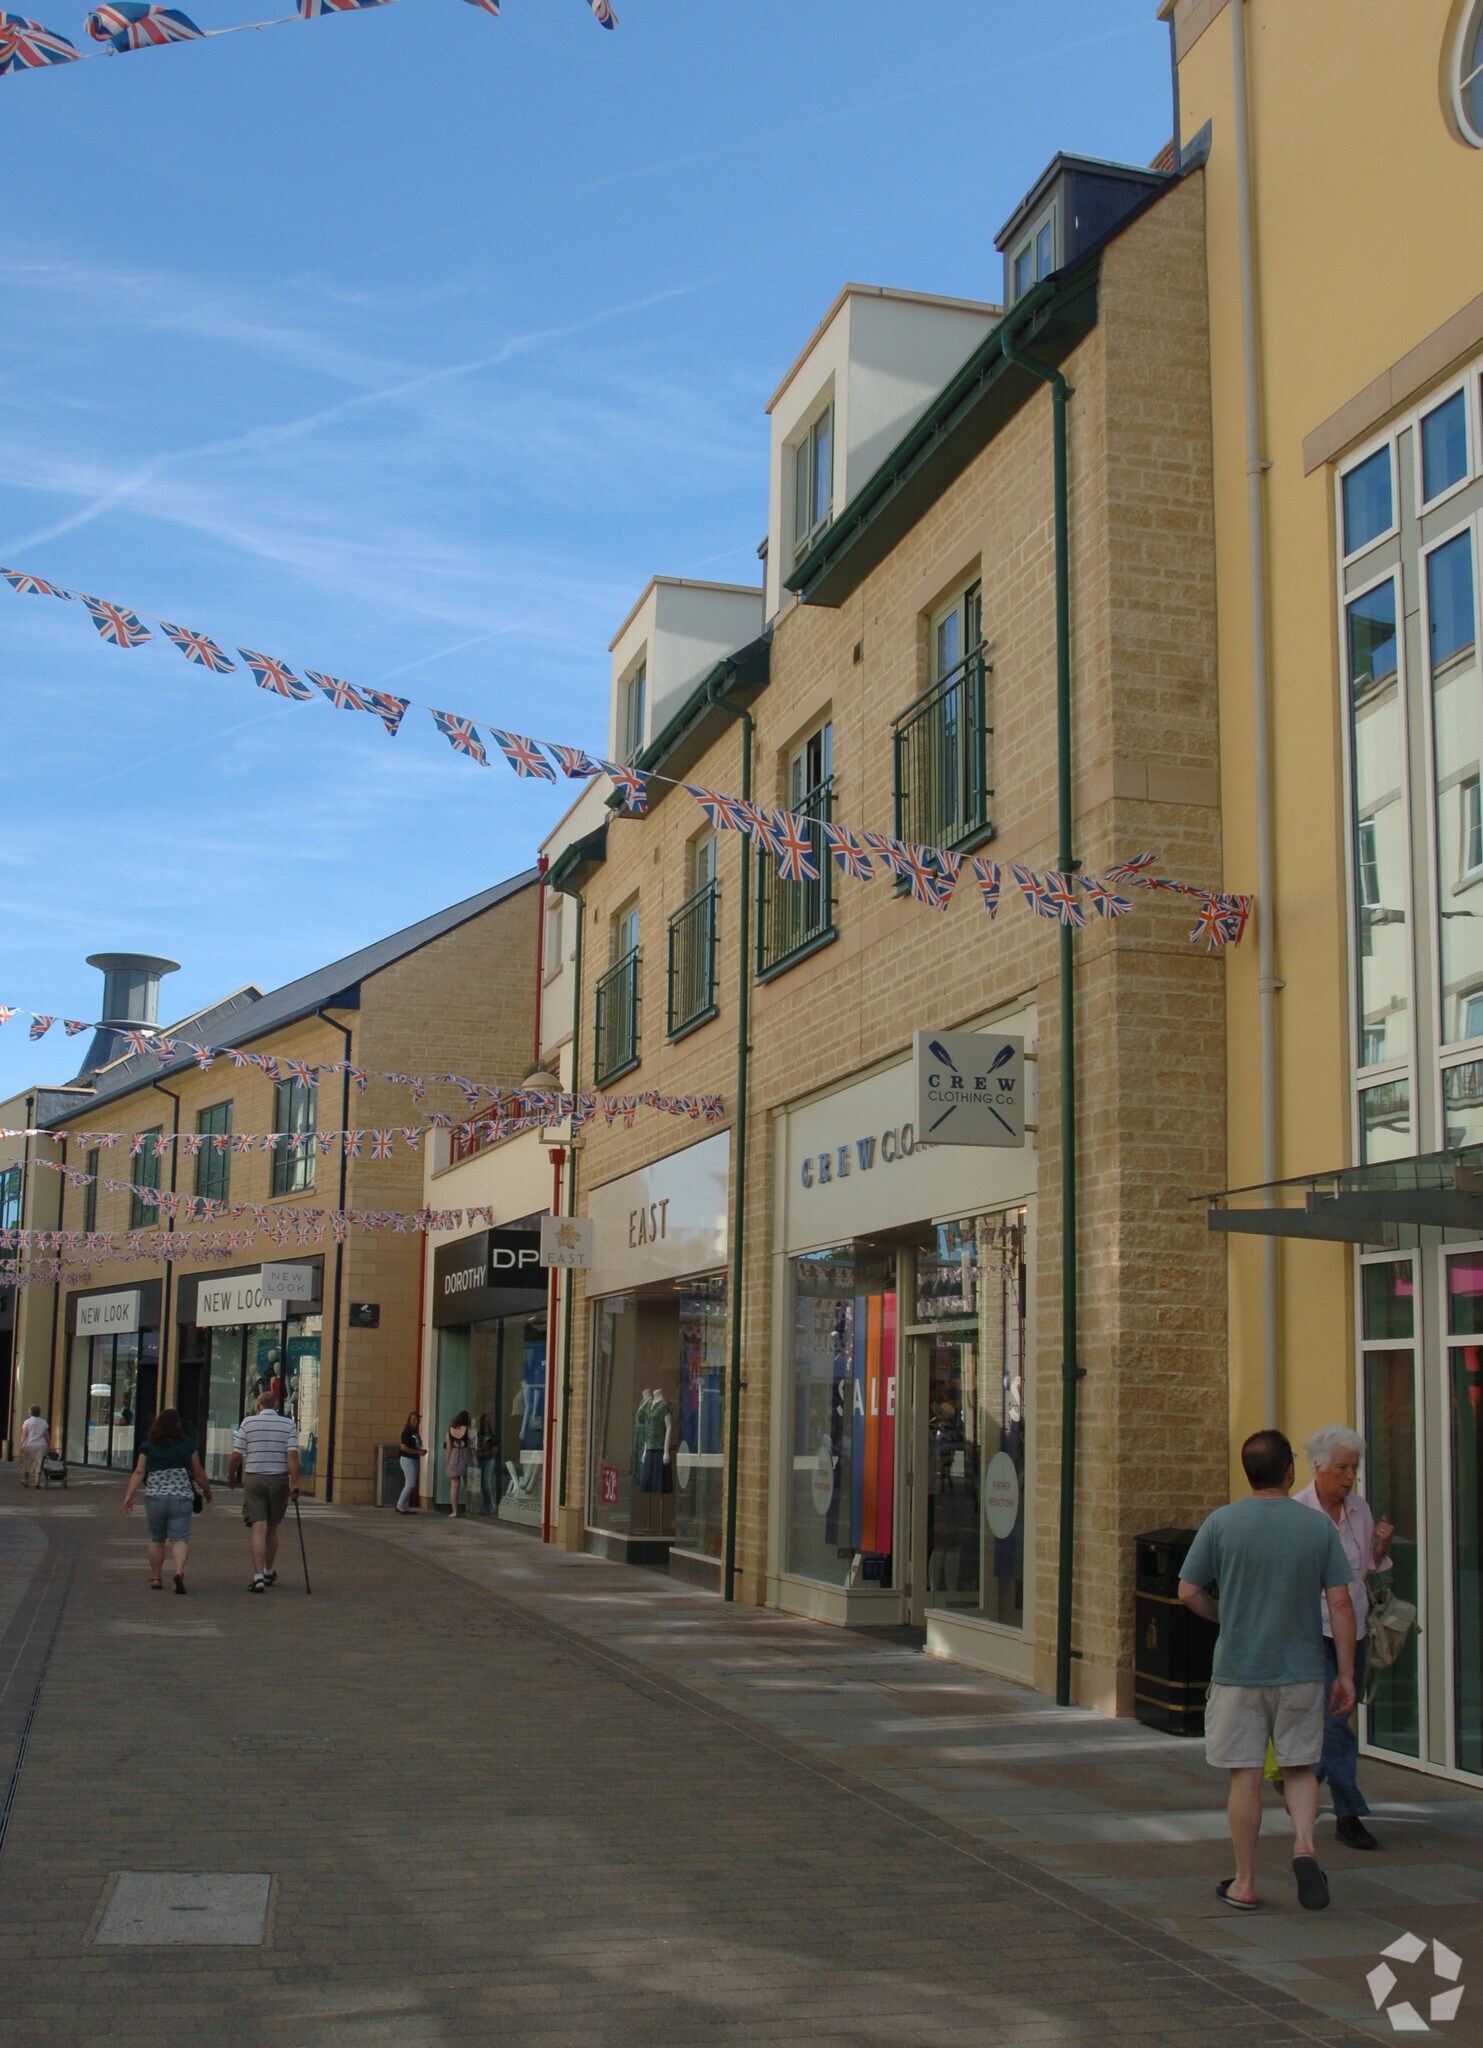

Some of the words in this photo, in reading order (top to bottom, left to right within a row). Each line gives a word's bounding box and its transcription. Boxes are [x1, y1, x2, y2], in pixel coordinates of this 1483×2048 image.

[928, 1074, 1016, 1092] CREW
[928, 1090, 993, 1105] CLOTHING
[800, 1135, 876, 1189] CREW
[628, 1198, 671, 1248] EAST
[492, 1248, 540, 1269] DP
[547, 1253, 586, 1265] EAST
[271, 1272, 303, 1281] NEW
[444, 1265, 487, 1295] DOROTHY
[268, 1283, 305, 1292] LOOK
[203, 1291, 232, 1313] NEW
[81, 1307, 102, 1324] NEW
[104, 1303, 130, 1322] LOOK
